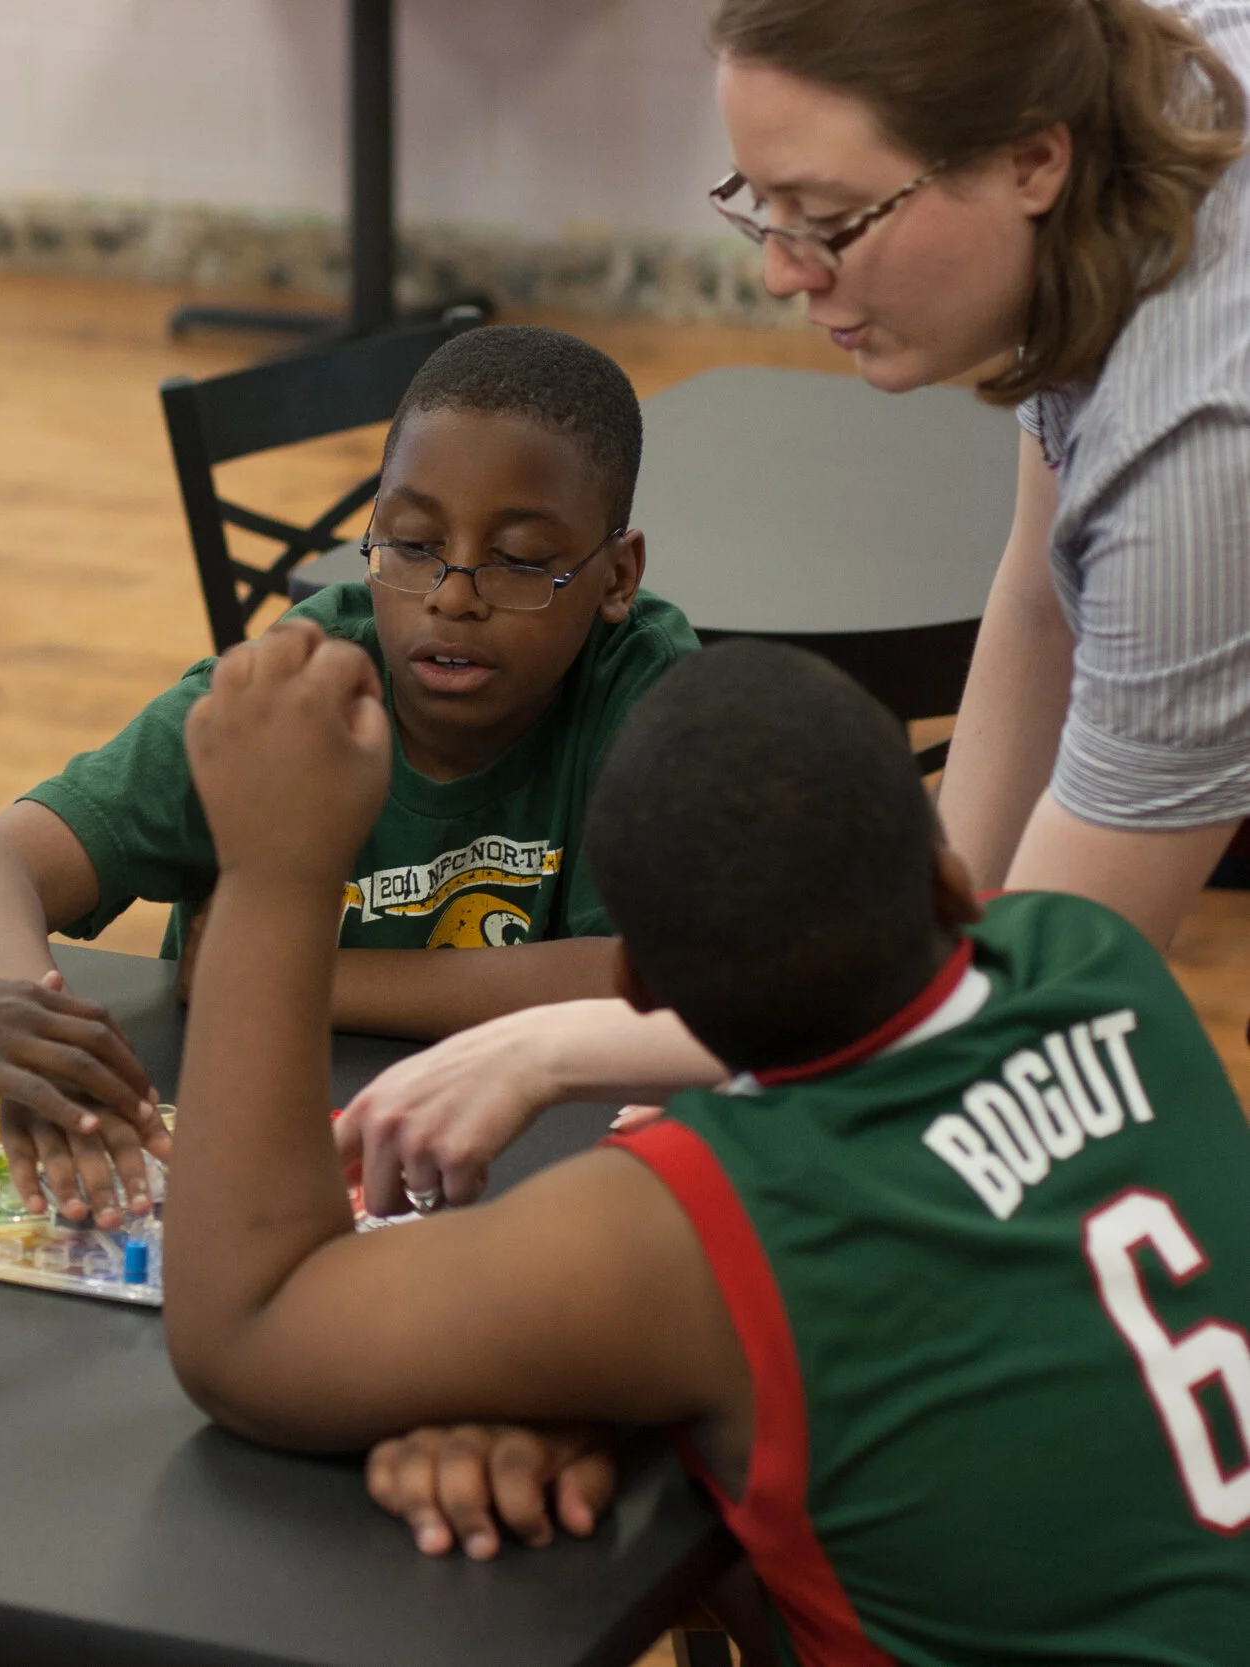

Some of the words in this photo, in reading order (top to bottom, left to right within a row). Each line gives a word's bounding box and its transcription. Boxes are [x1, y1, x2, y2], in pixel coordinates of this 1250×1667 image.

[380, 868, 421, 900] 2011
[427, 852, 467, 892] NFC
[921, 1009, 1154, 1220] BOGUT
[1081, 1188, 1250, 1535] 6
